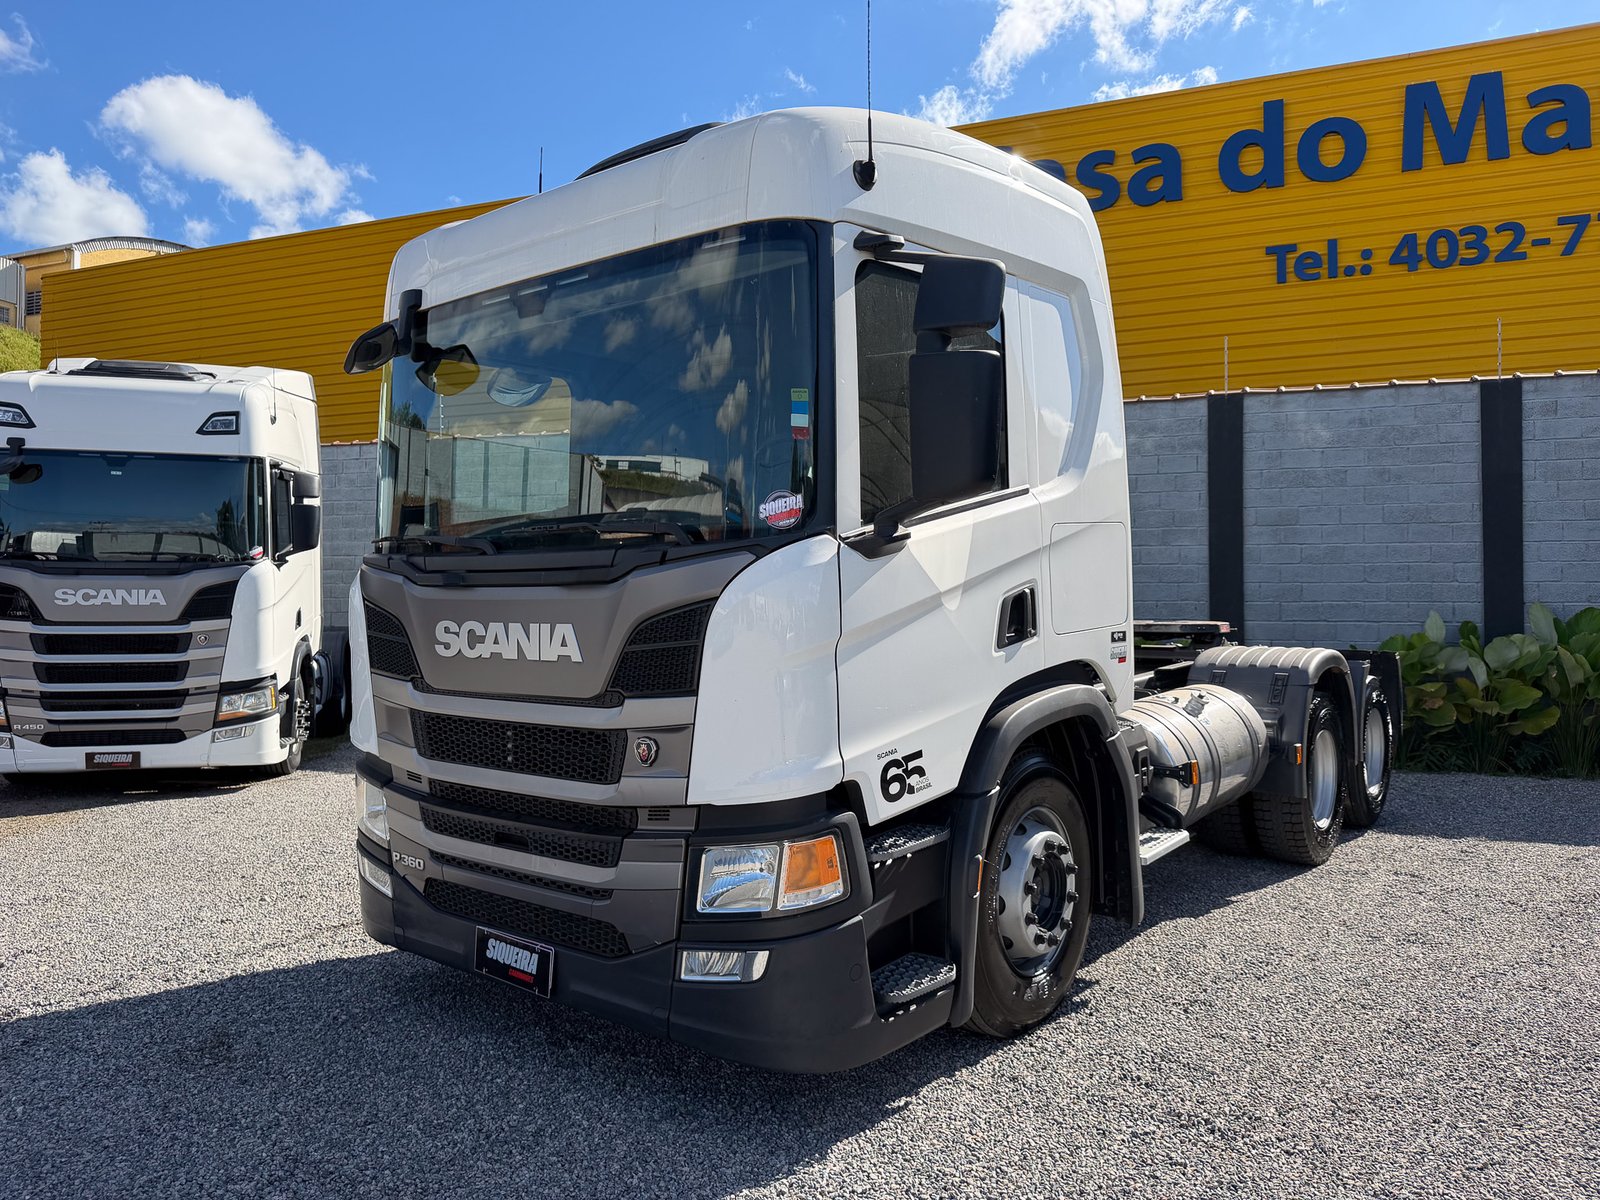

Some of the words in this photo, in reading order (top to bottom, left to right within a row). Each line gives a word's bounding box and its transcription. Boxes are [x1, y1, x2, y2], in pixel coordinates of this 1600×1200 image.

[994, 143, 1183, 212] sa
[1217, 98, 1368, 193] do
[1402, 70, 1593, 173] Ma
[1265, 238, 1373, 285] Tel.:
[1388, 212, 1600, 272] 4032-7
[759, 494, 803, 518] SIQUEIRA
[54, 588, 167, 606] SCANIA
[434, 620, 584, 663] SCANIA
[93, 753, 133, 763] SIQUEIRA
[877, 748, 898, 760] SCANIA
[880, 749, 926, 802] 65
[392, 851, 401, 863] P
[401, 854, 424, 871] 360
[486, 938, 539, 974] SIQUEIRA
